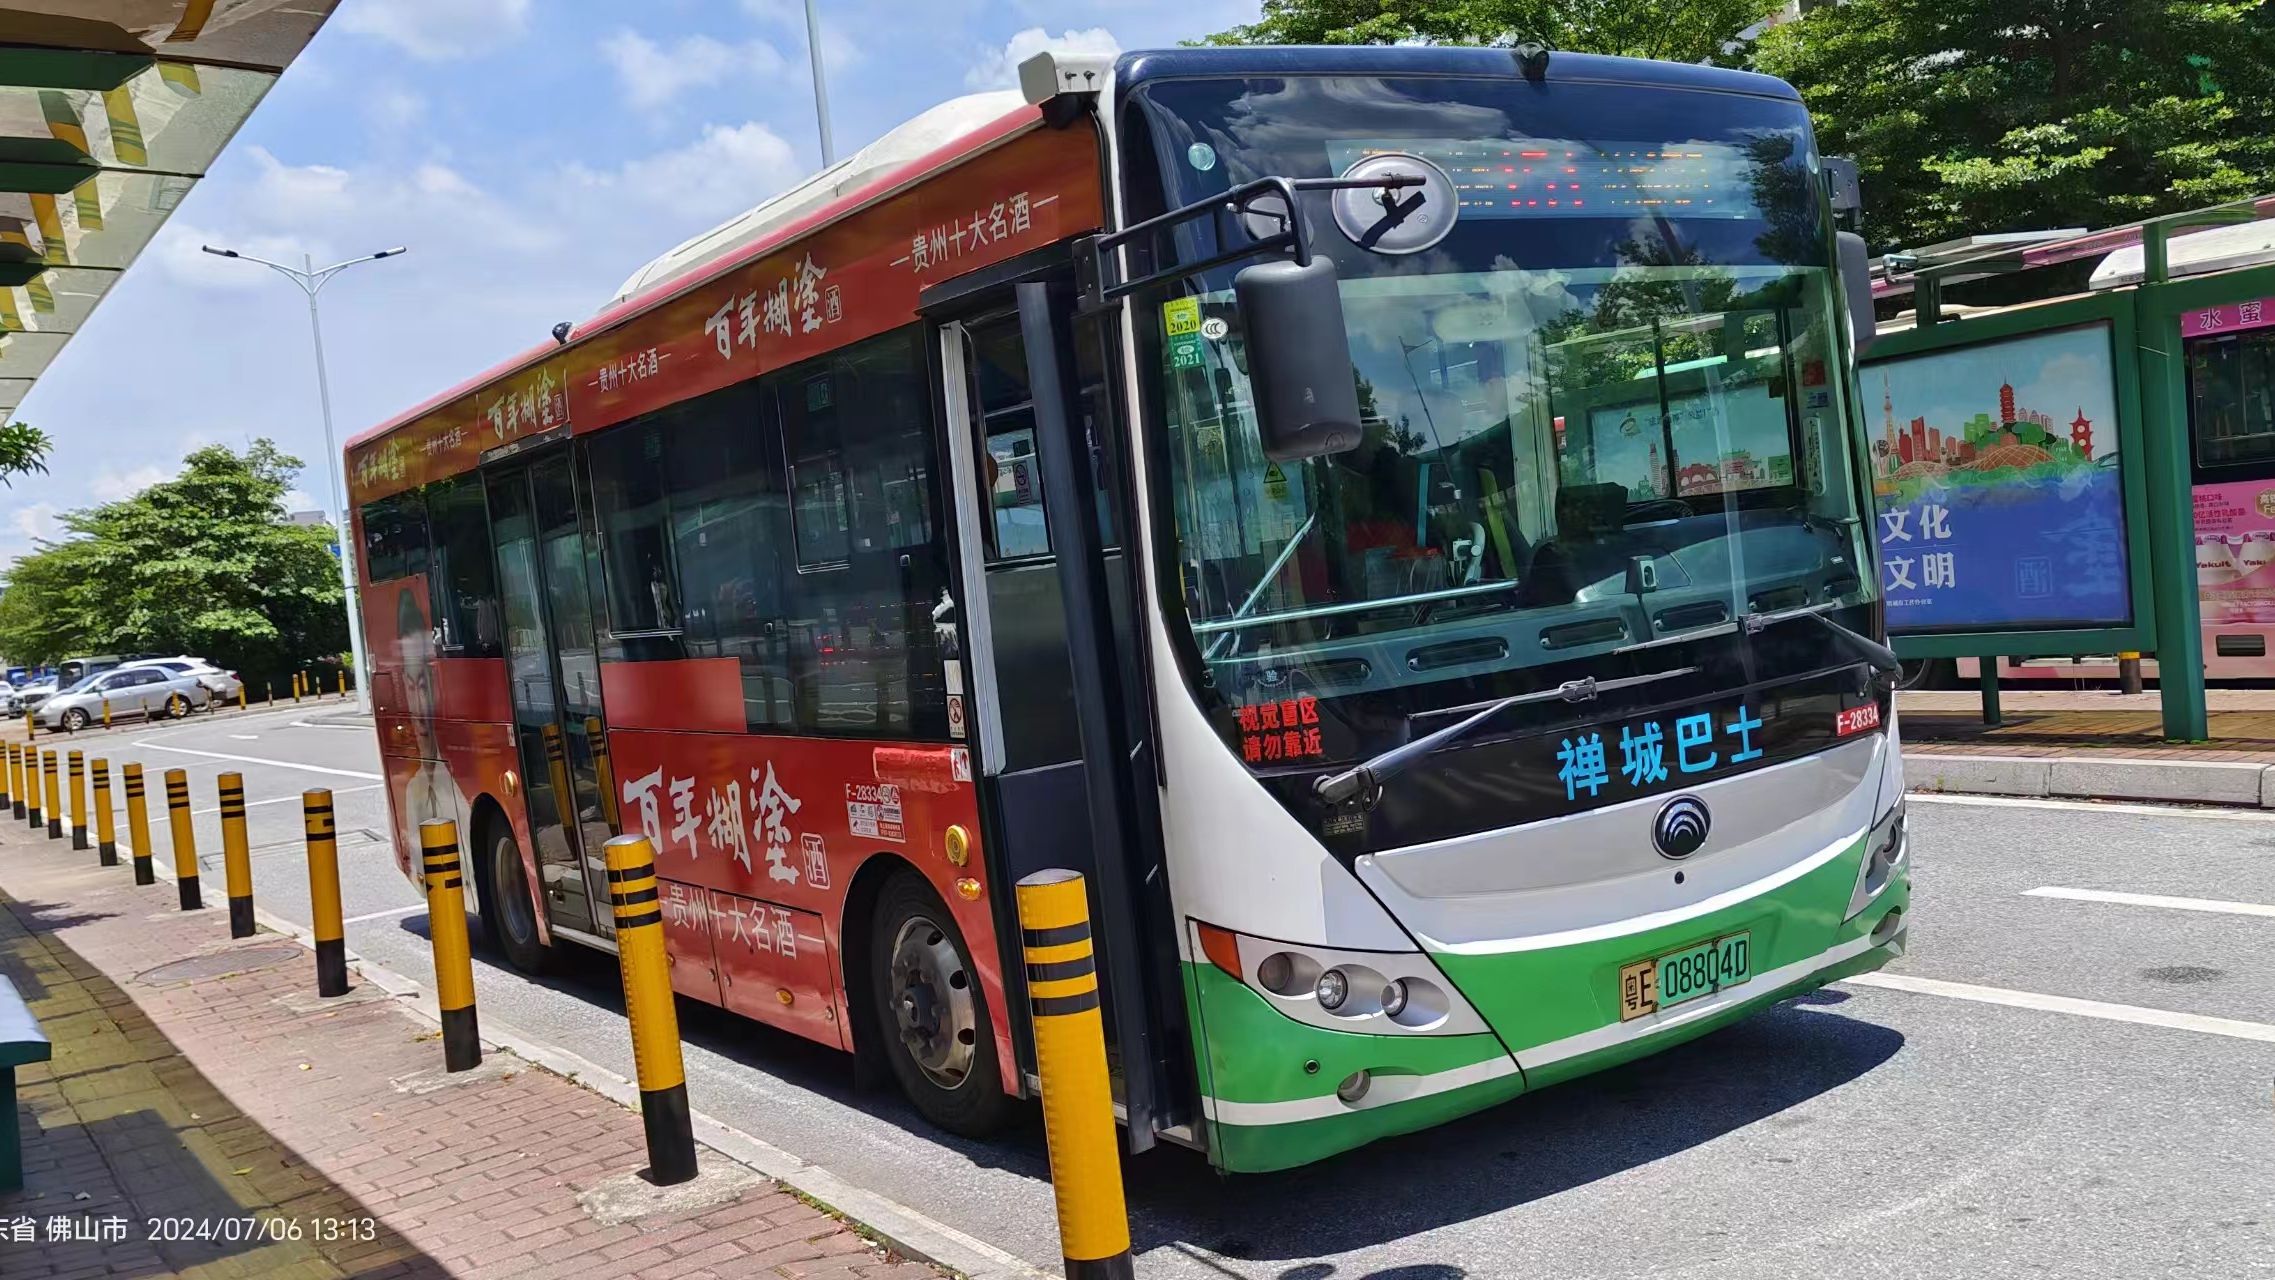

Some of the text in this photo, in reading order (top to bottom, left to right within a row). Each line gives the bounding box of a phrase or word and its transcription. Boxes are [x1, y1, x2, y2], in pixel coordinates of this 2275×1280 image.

[705, 252, 827, 360] 百年糊涂
[1170, 320, 1197, 333] 2020
[1174, 353, 1200, 367] 2021
[1880, 505, 1952, 544] 文化
[1884, 552, 1956, 591] 文明
[1239, 696, 1319, 731] 视觉盲区
[1837, 704, 1878, 734] F-28334
[1242, 727, 1323, 762] 请勿靠近
[1557, 705, 1763, 800] 禅城巴士
[623, 760, 802, 885] 百年糊涂
